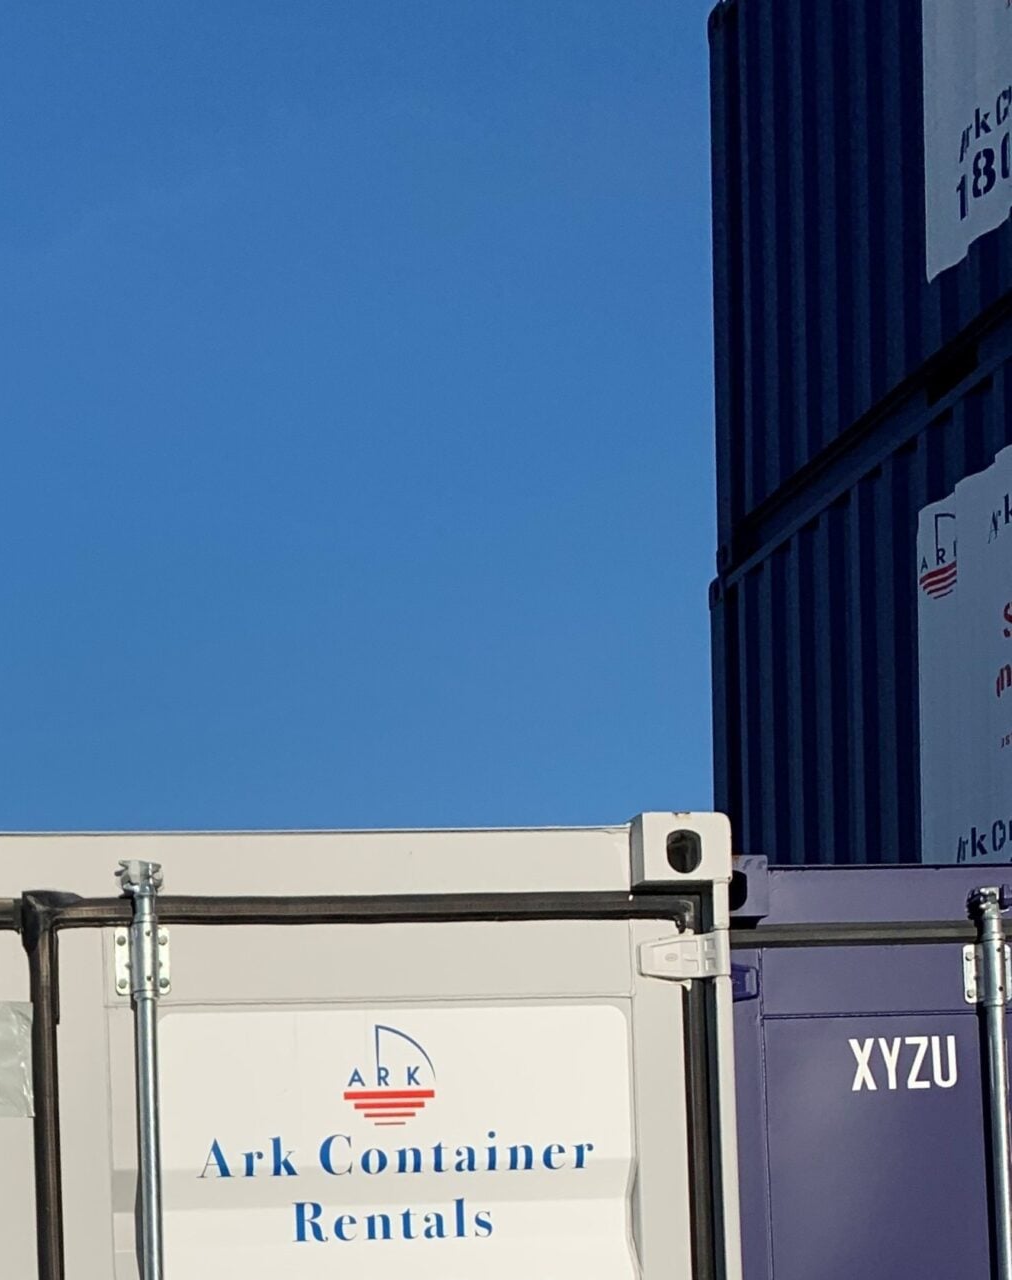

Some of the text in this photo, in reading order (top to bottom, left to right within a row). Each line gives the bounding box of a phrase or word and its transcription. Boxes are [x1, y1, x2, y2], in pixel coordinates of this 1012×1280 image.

[347, 1066, 421, 1087] ARK
[848, 1035, 958, 1091] XYZU
[197, 1131, 594, 1178] Ark Container
[292, 1198, 495, 1243] Rentals
